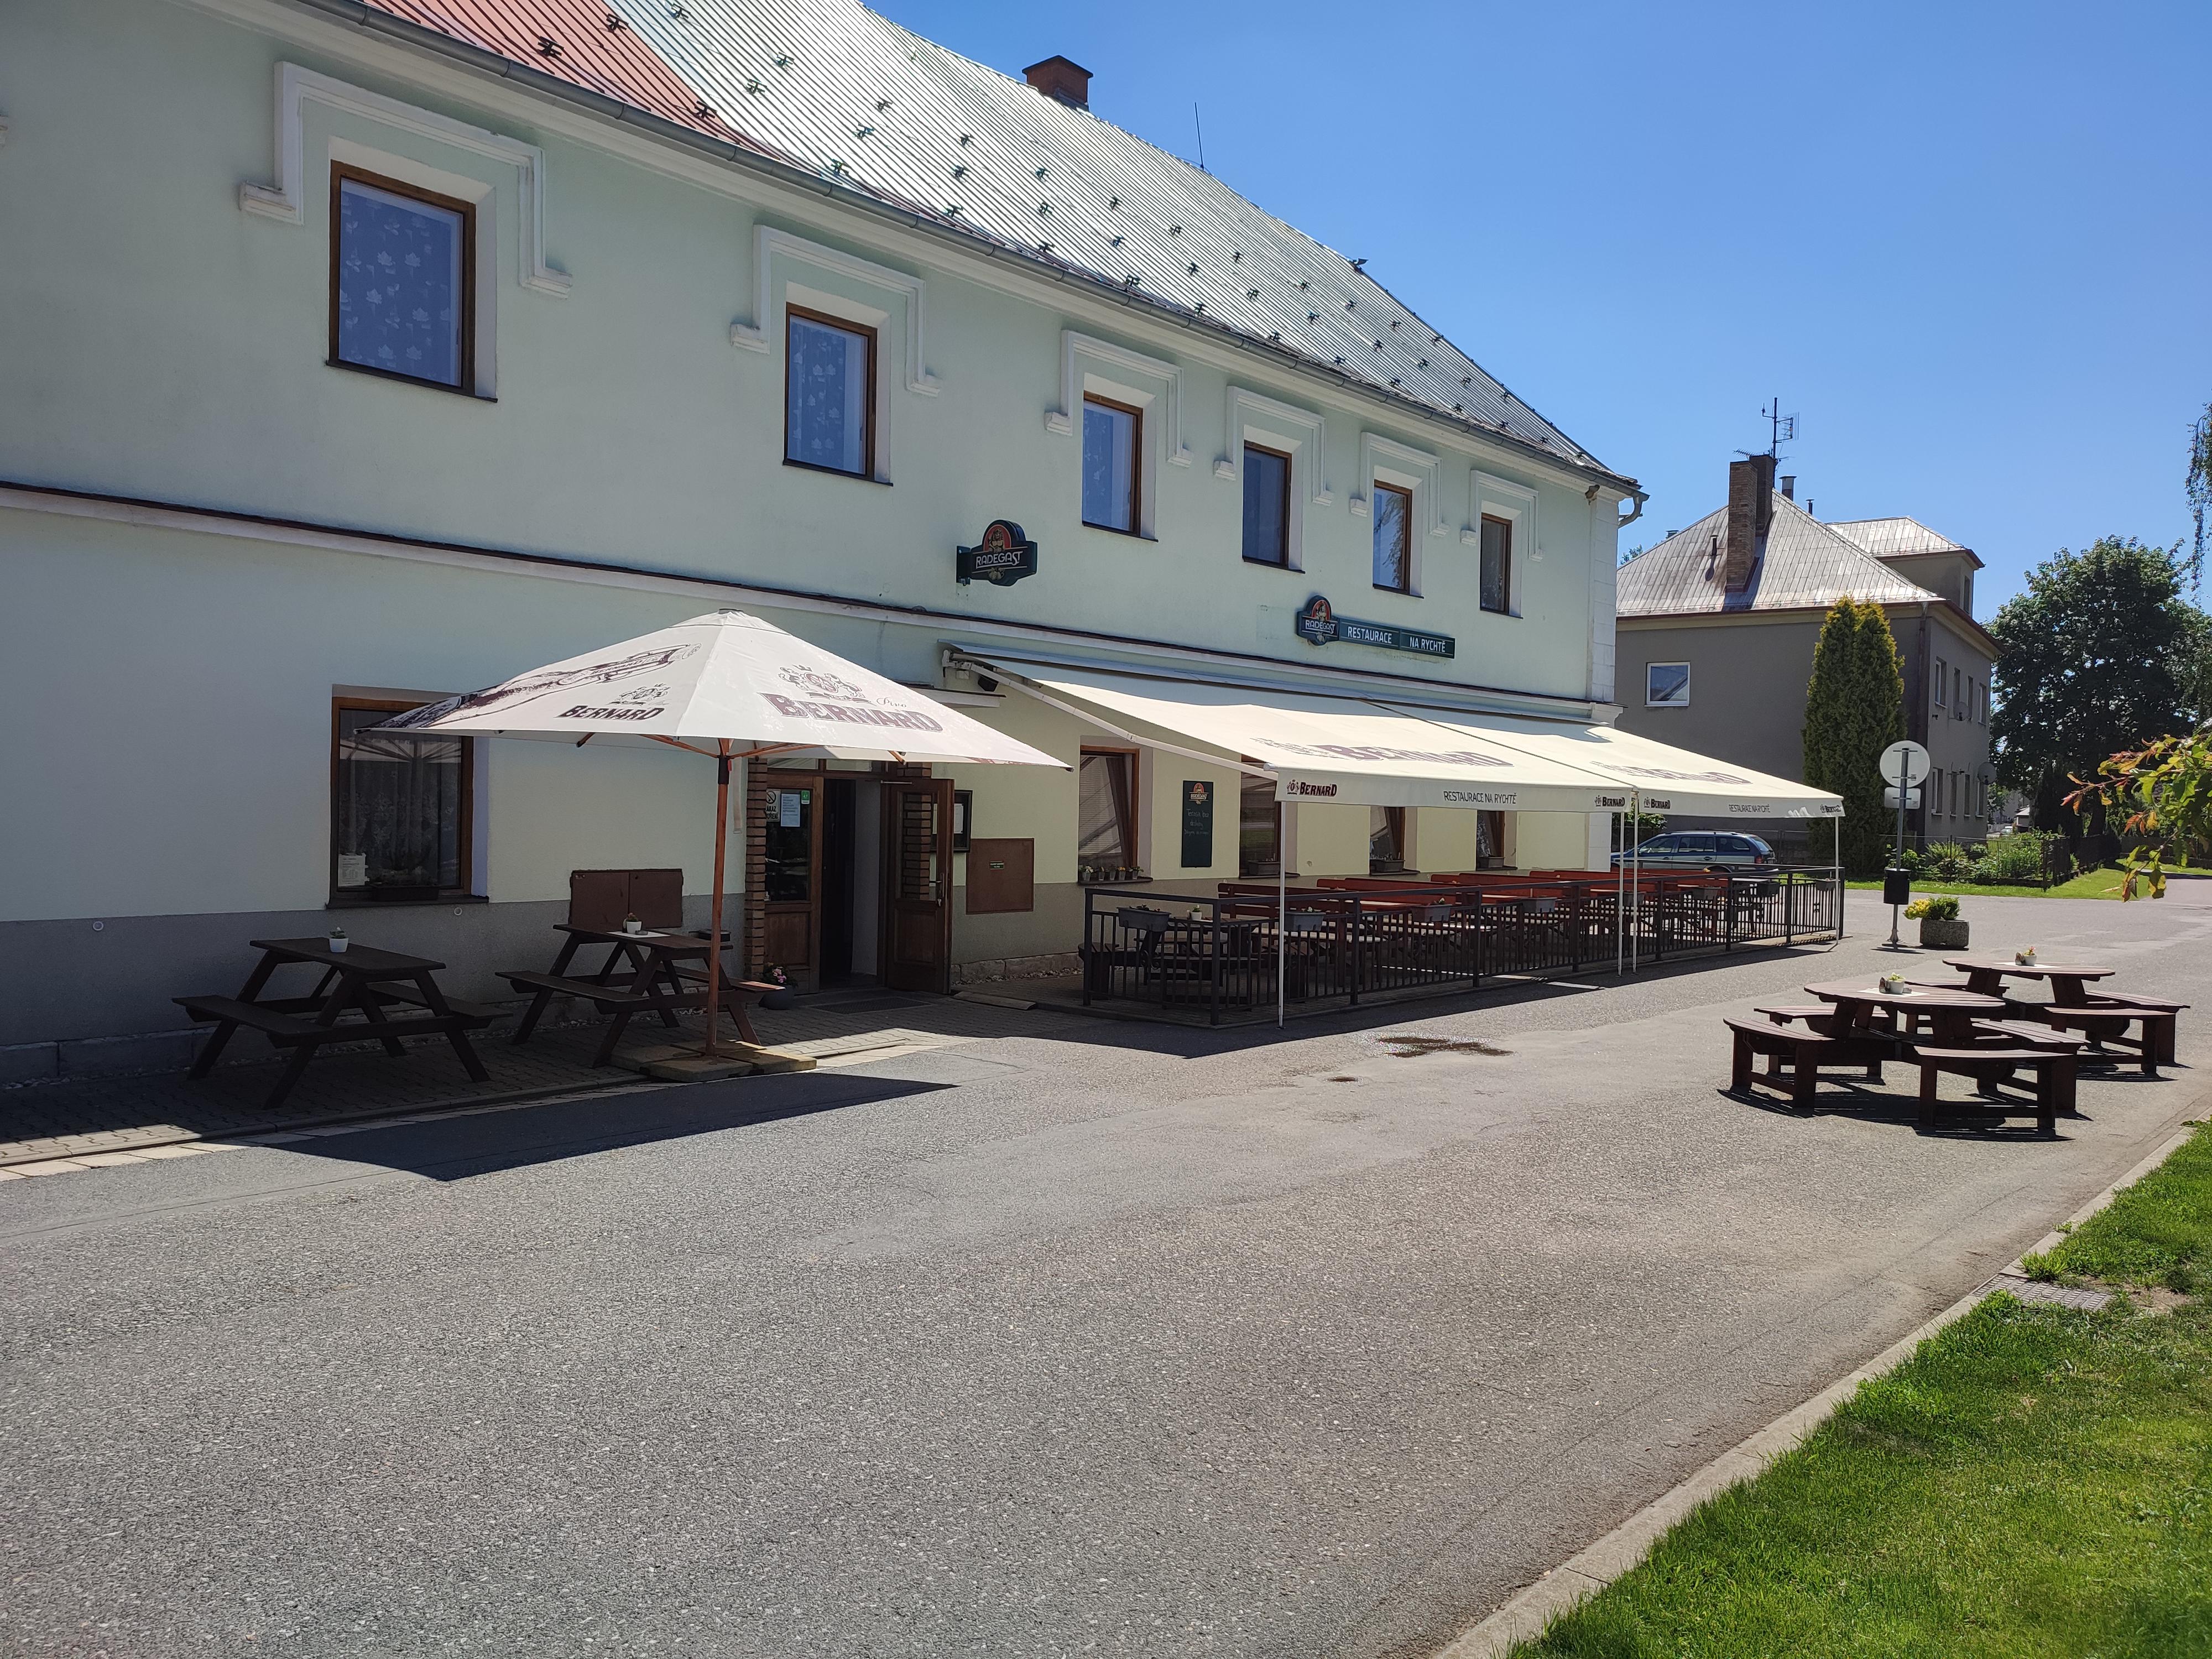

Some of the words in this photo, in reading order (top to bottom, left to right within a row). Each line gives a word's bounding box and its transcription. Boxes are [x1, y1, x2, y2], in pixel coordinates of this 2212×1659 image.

[976, 551, 1023, 569] RADEGAST
[1305, 619, 1335, 634] RADEGAST
[1348, 625, 1392, 644] RESTAURACE
[1410, 636, 1419, 649] NA
[1421, 639, 1446, 653] RYCHTĚ
[876, 696, 907, 708] Pivo
[557, 705, 665, 721] BERNARD
[757, 692, 943, 733] BERNARD
[1307, 744, 1515, 767] BERNARD
[1299, 781, 1337, 797] BERNARD
[1443, 791, 1484, 802] RESTAURACE
[1485, 794, 1493, 804] NA
[1494, 792, 1517, 804] RYCHTĚ
[1602, 796, 1625, 807] BERNARD
